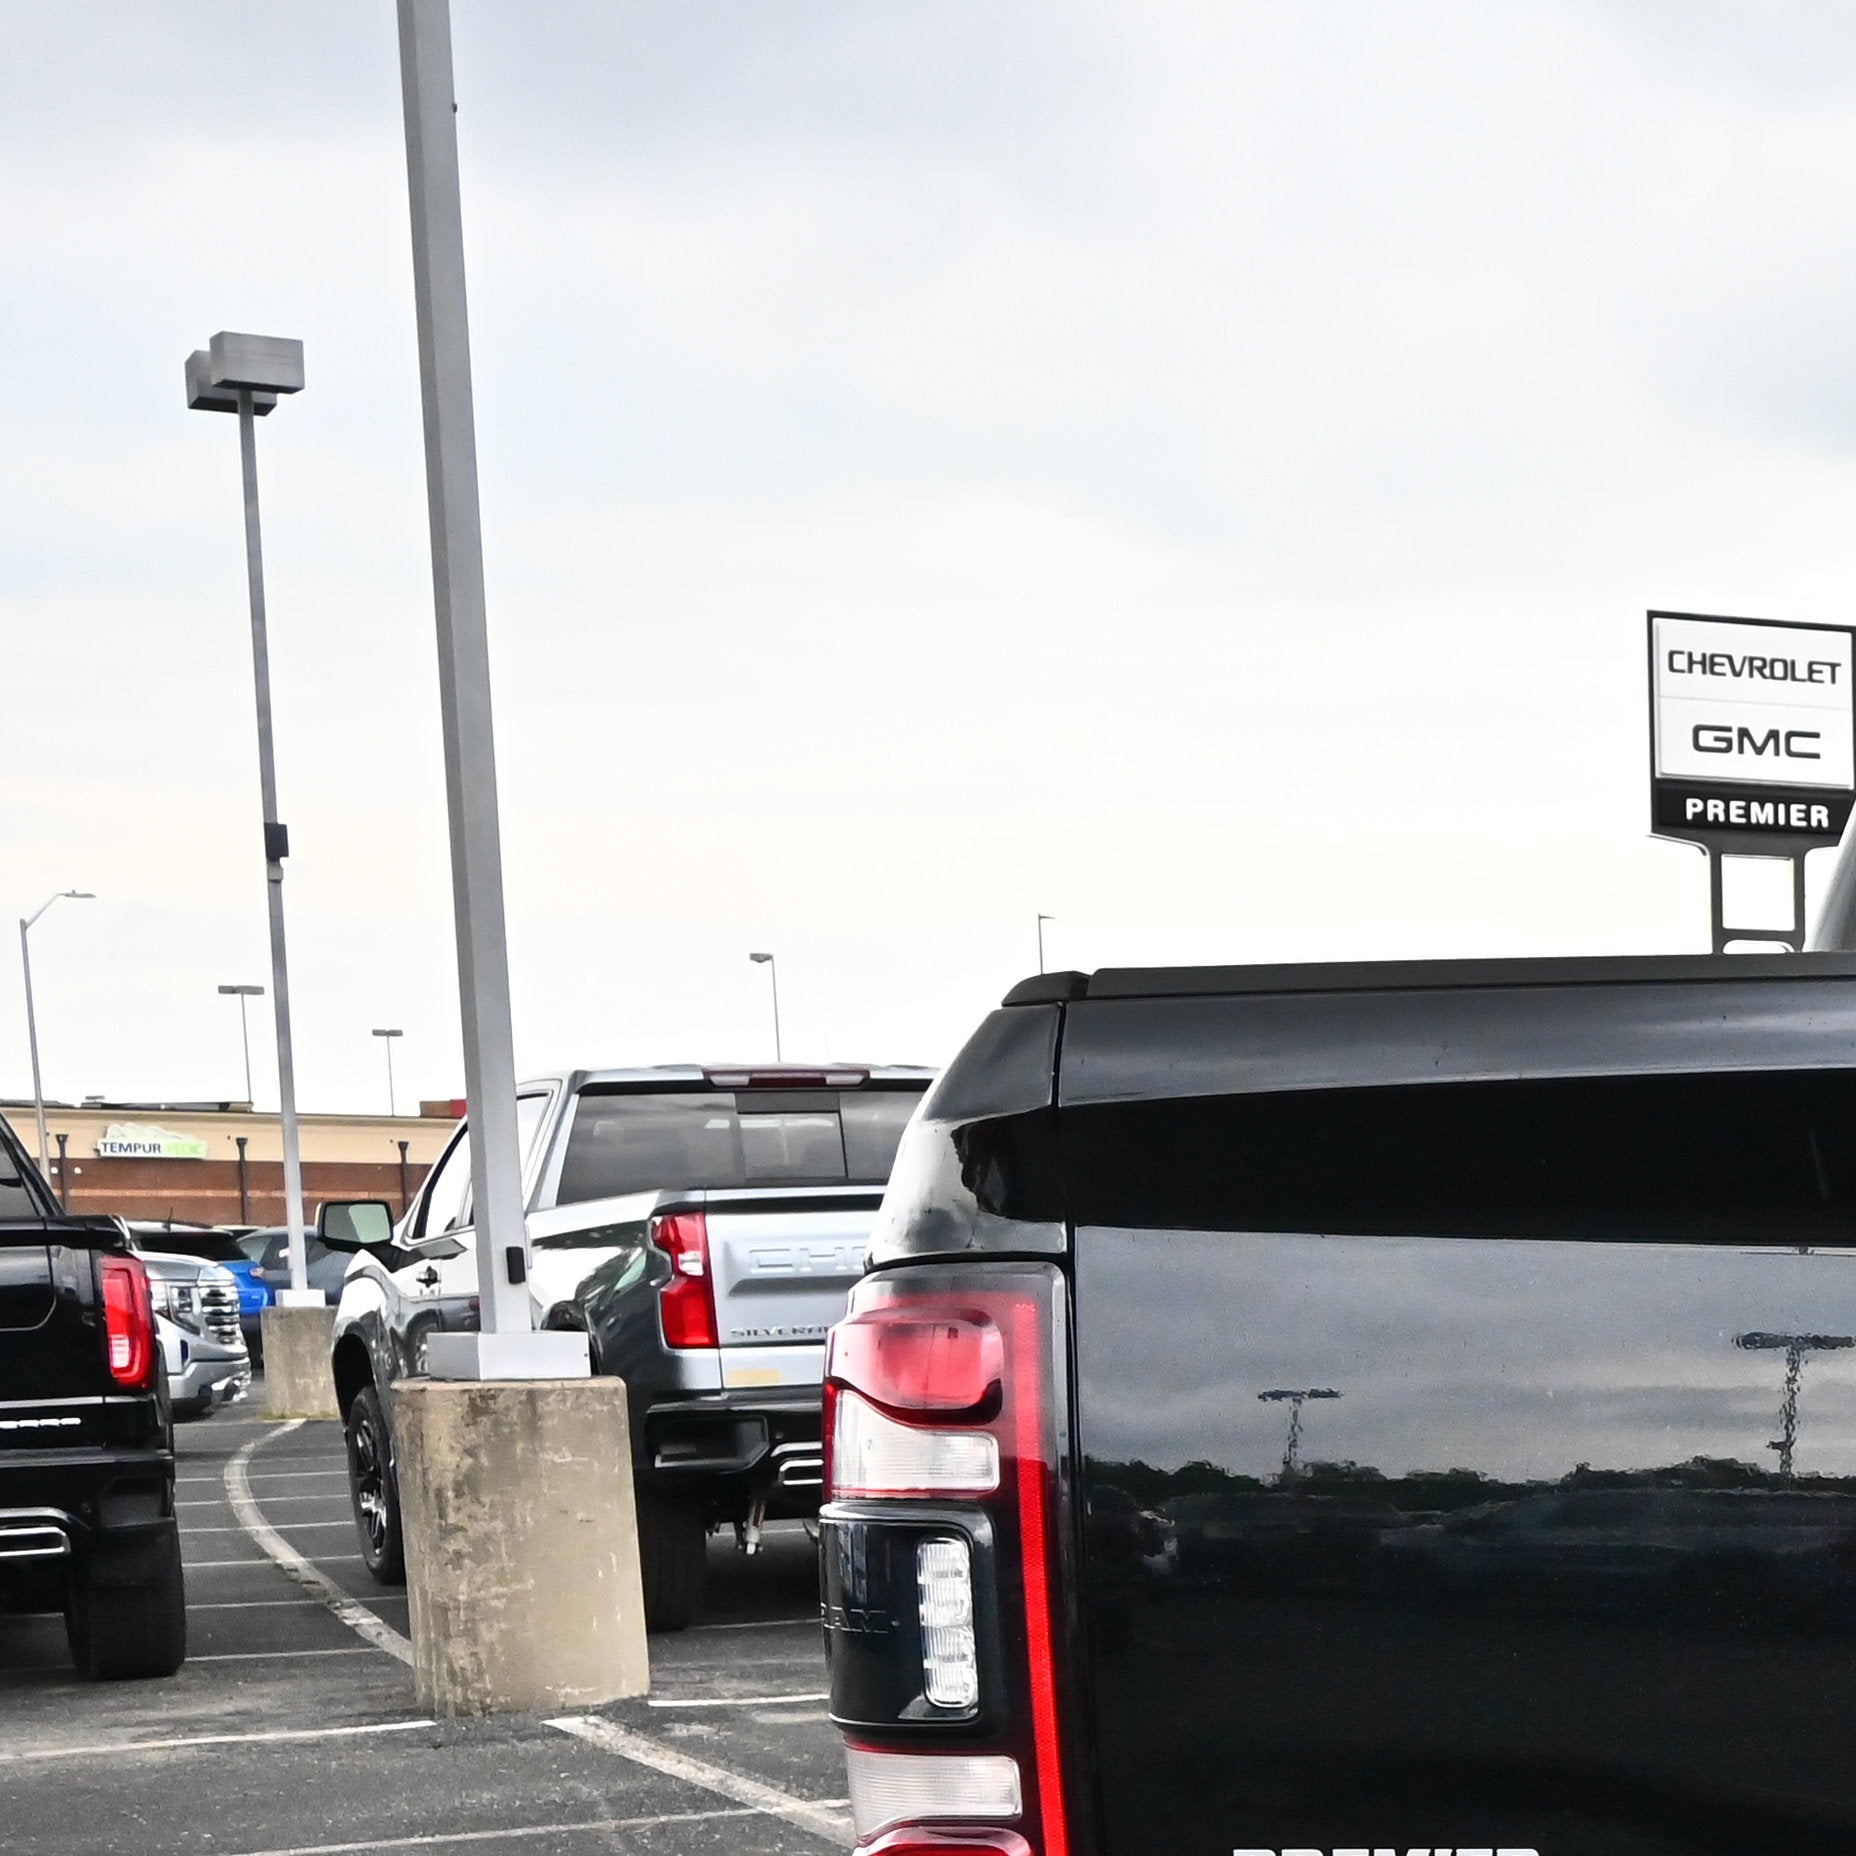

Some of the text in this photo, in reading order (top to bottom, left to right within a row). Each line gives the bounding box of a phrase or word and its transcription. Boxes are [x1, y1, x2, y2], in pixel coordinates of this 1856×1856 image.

[1667, 650, 1842, 684] CHEVROLET
[1692, 724, 1821, 760] GMC
[1685, 798, 1830, 828] PREMIER
[101, 1142, 162, 1154] TEMPUR
